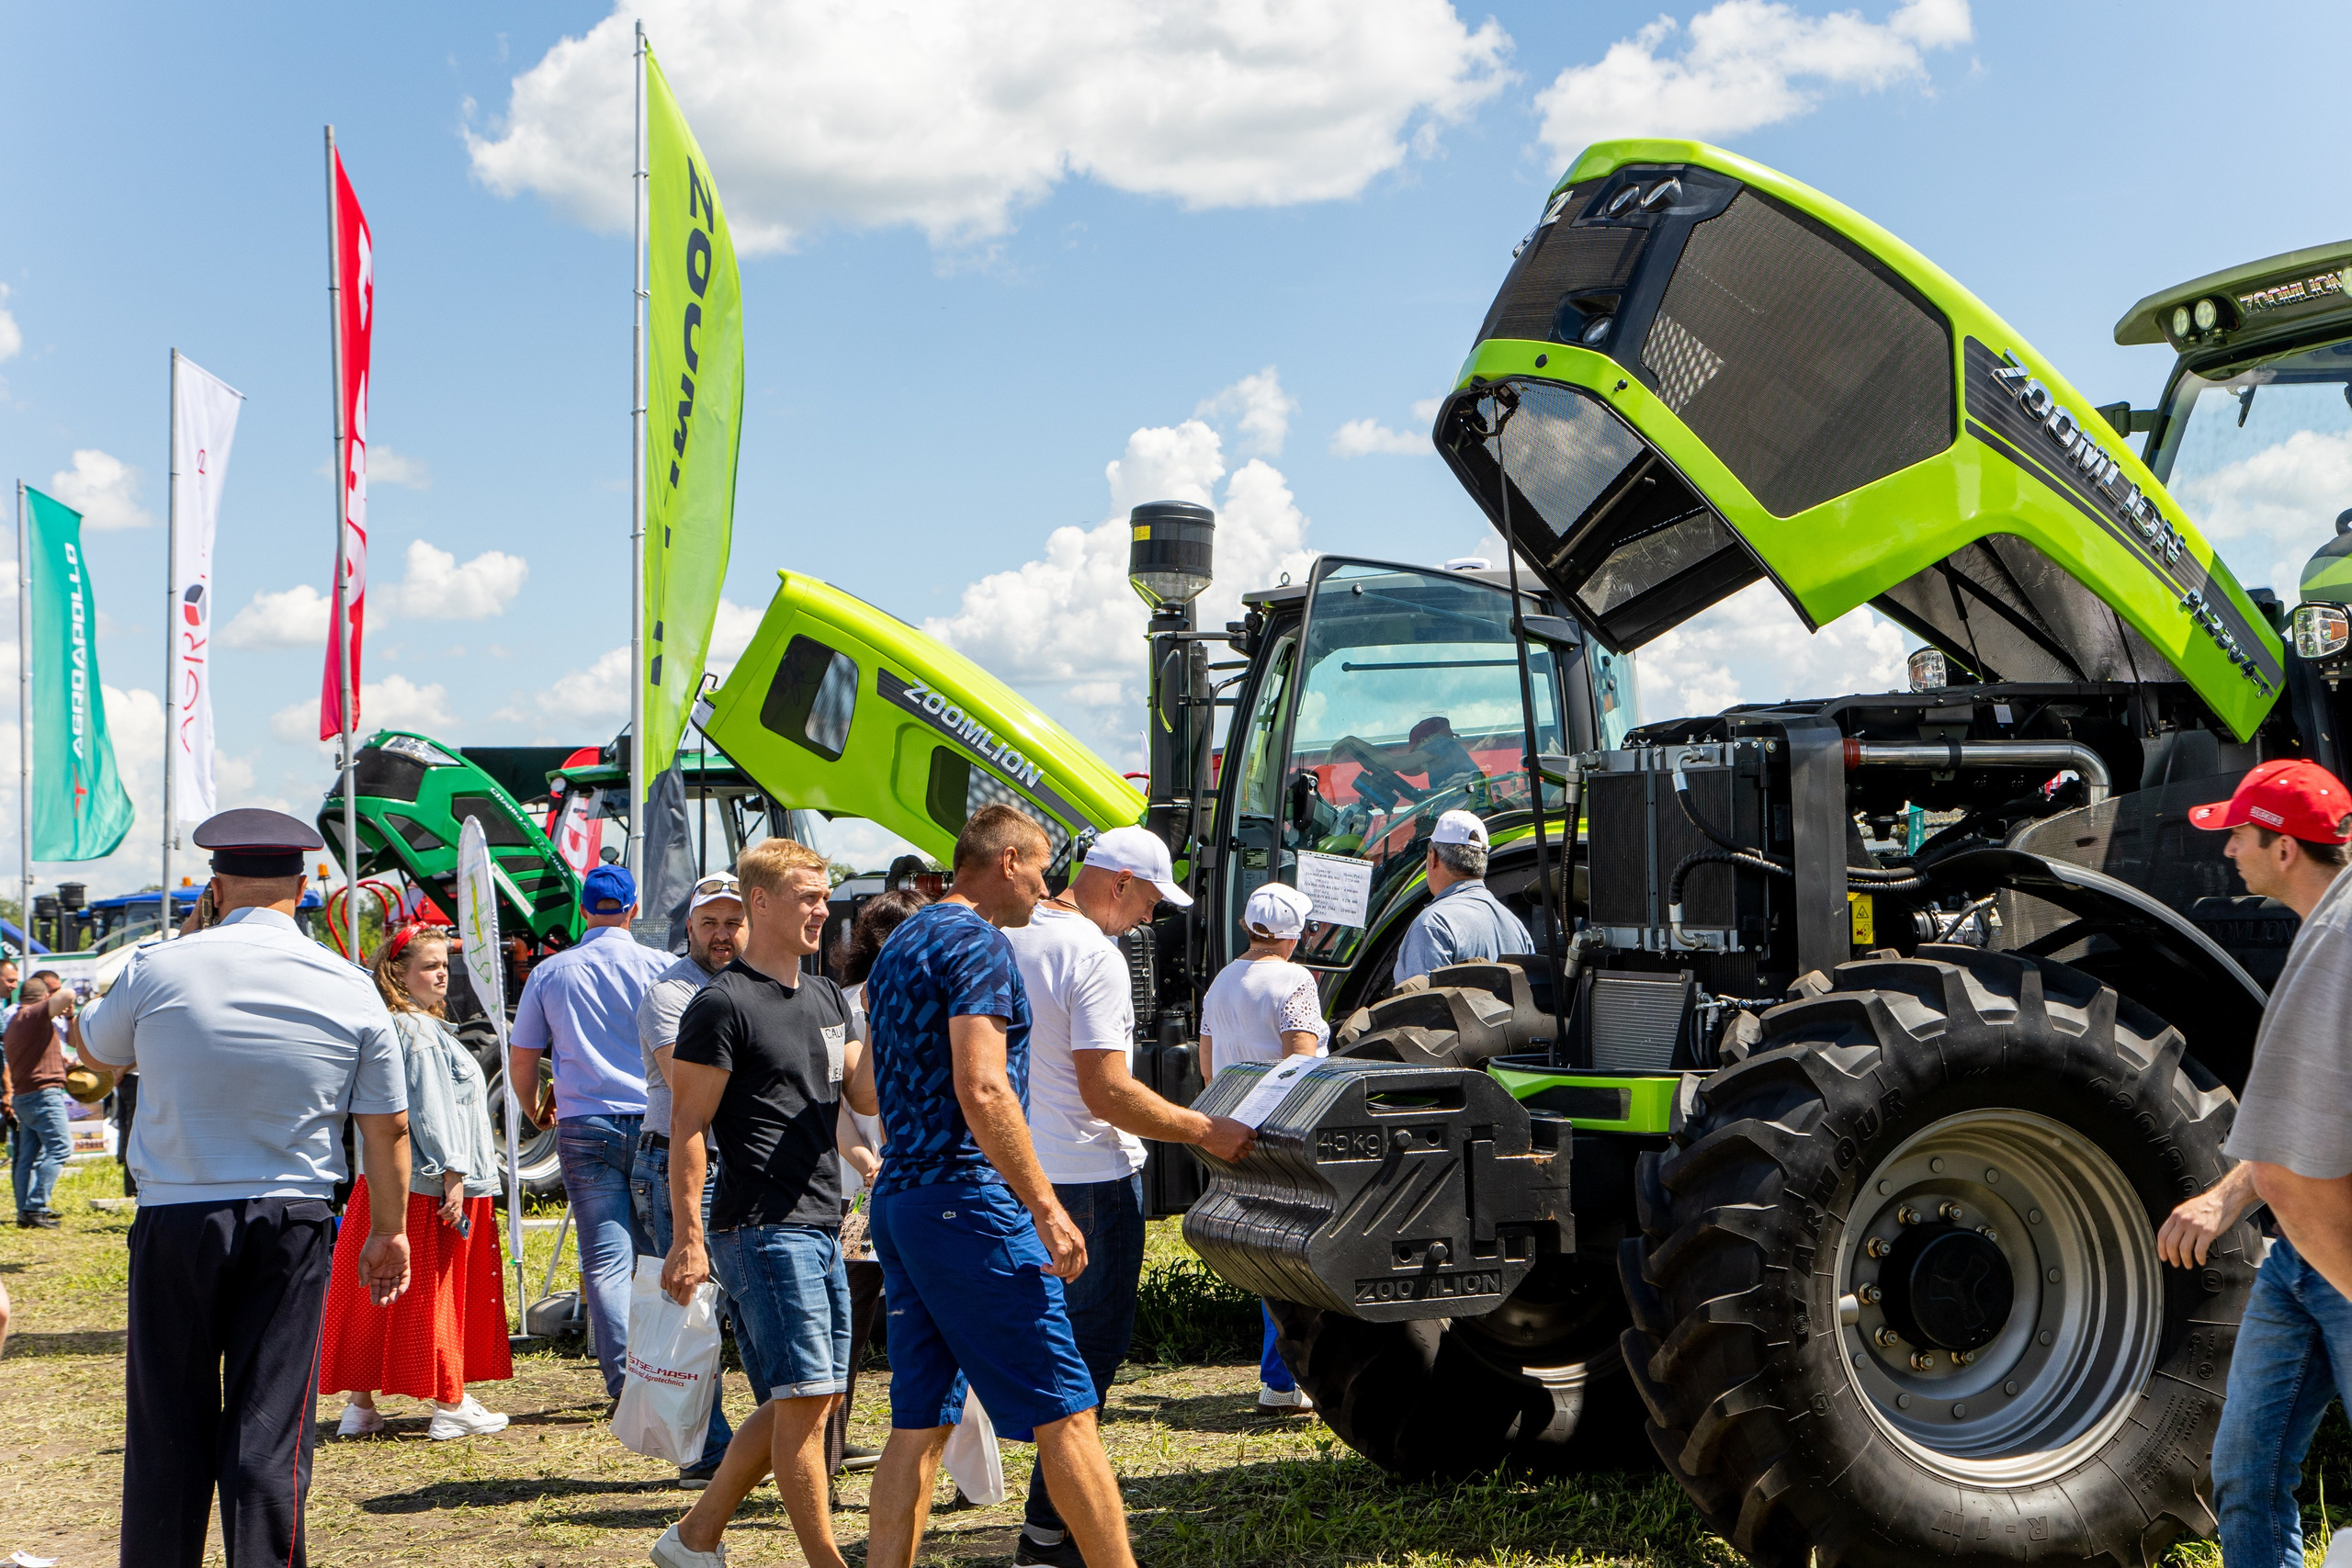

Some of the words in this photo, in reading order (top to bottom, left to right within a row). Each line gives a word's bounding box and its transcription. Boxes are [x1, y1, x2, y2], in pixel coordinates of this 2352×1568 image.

[1990, 347, 2186, 569] ZOOMLION
[64, 542, 86, 760] AGROAPOLLO
[903, 678, 1044, 788] ZOOMLION
[1793, 1087, 1905, 1279] ARMOUR
[644, 1374, 684, 1387] Agrotechnics
